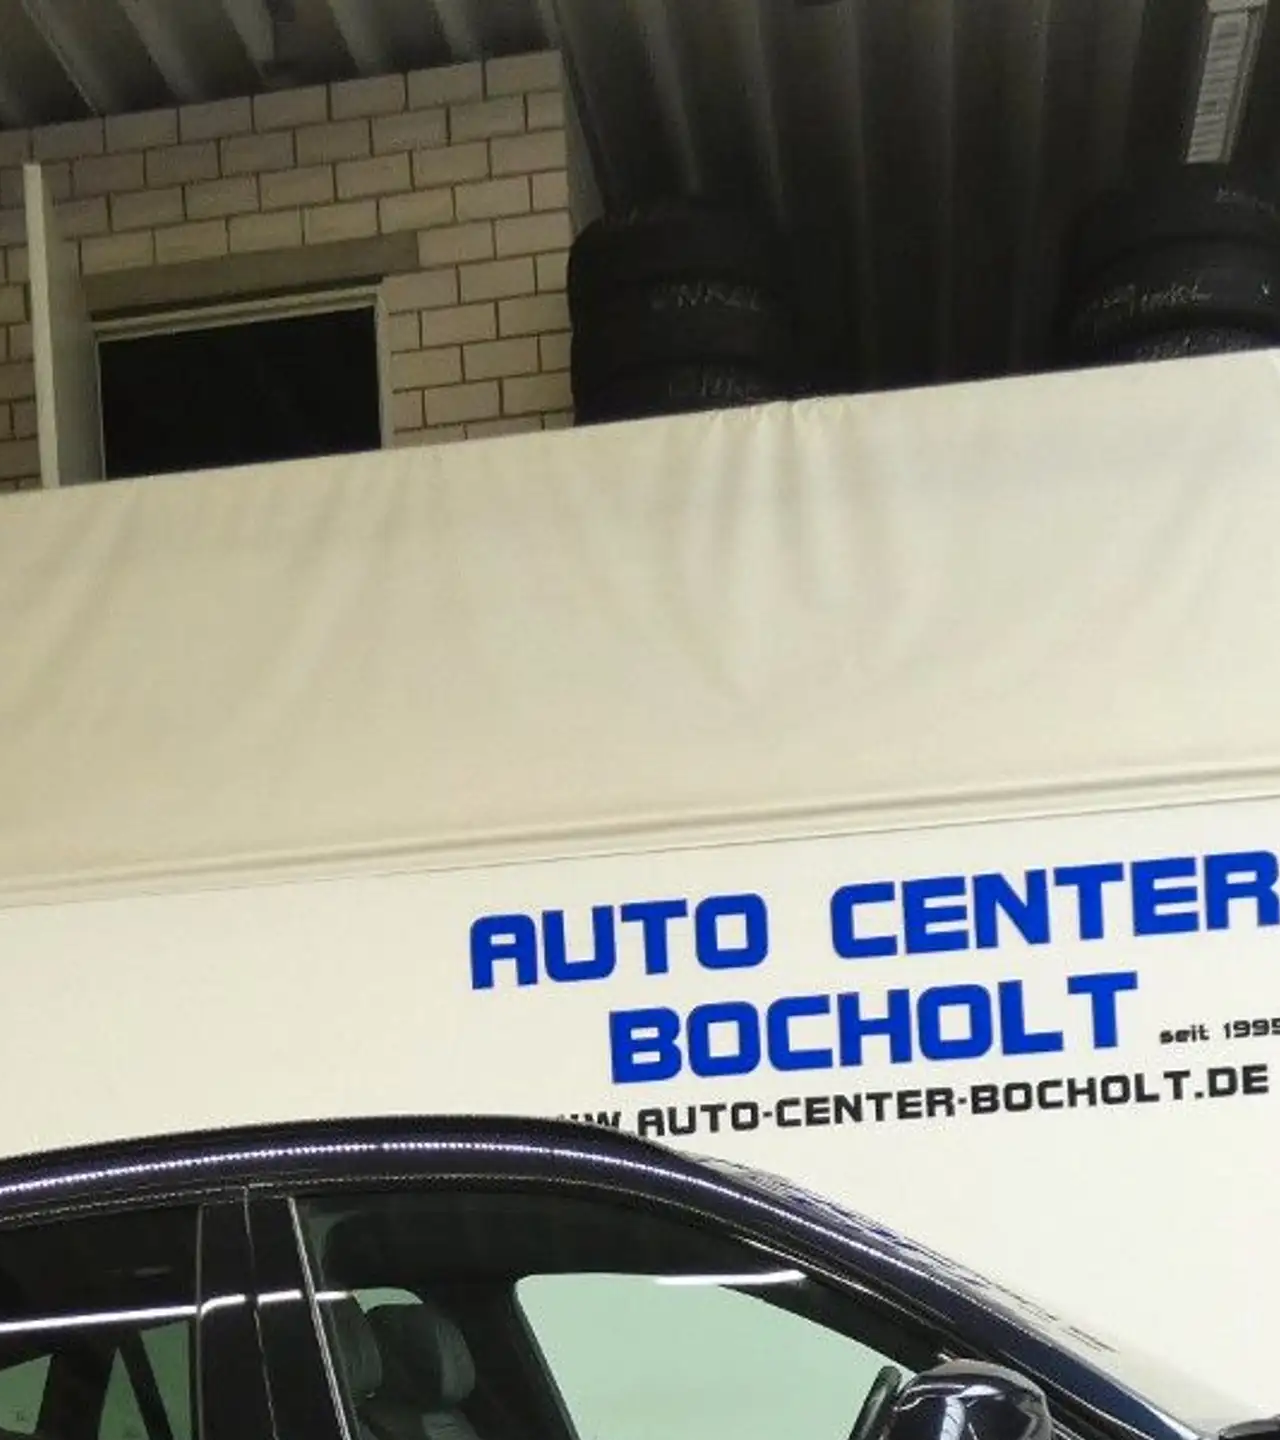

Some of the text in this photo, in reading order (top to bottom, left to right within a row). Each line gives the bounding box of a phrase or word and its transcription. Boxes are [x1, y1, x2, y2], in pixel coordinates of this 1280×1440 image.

[470, 851, 1280, 989] AUTO CENTER
[609, 972, 1137, 1084] BOCHOLT
[1160, 1025, 1209, 1044] seit
